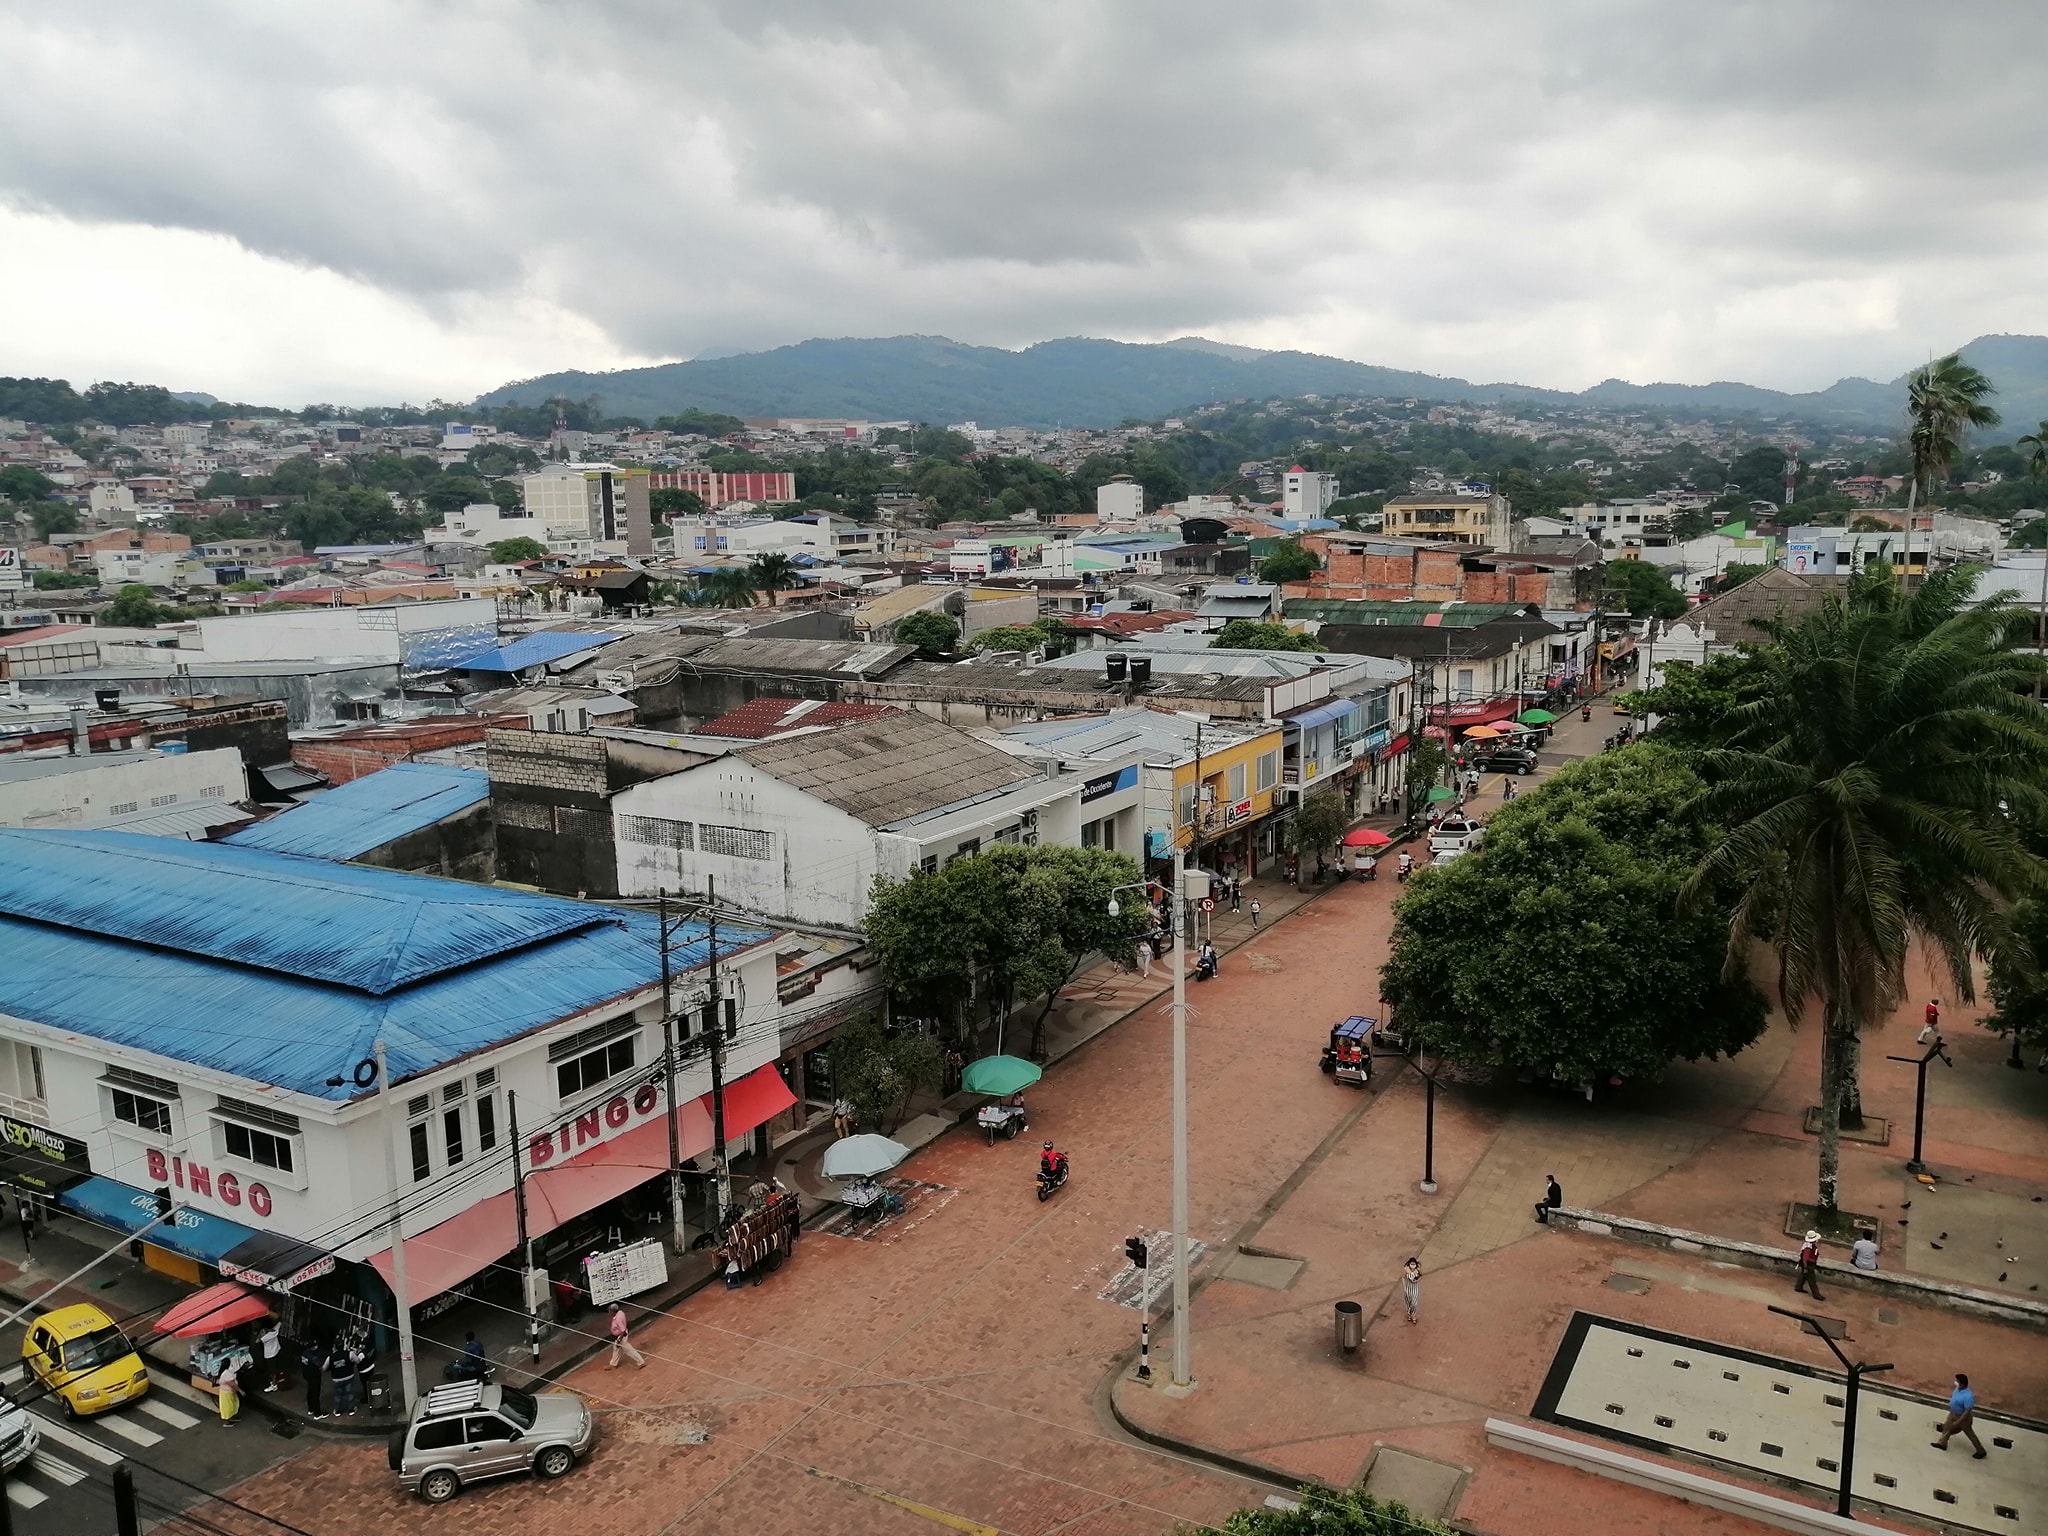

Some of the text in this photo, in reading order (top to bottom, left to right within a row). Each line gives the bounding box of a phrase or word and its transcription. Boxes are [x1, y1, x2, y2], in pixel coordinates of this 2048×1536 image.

[1090, 780, 1113, 795] Occidente
[529, 1084, 657, 1168] BINGO
[146, 1148, 272, 1217] BINGO
[292, 1256, 333, 1286] LOS REYES
